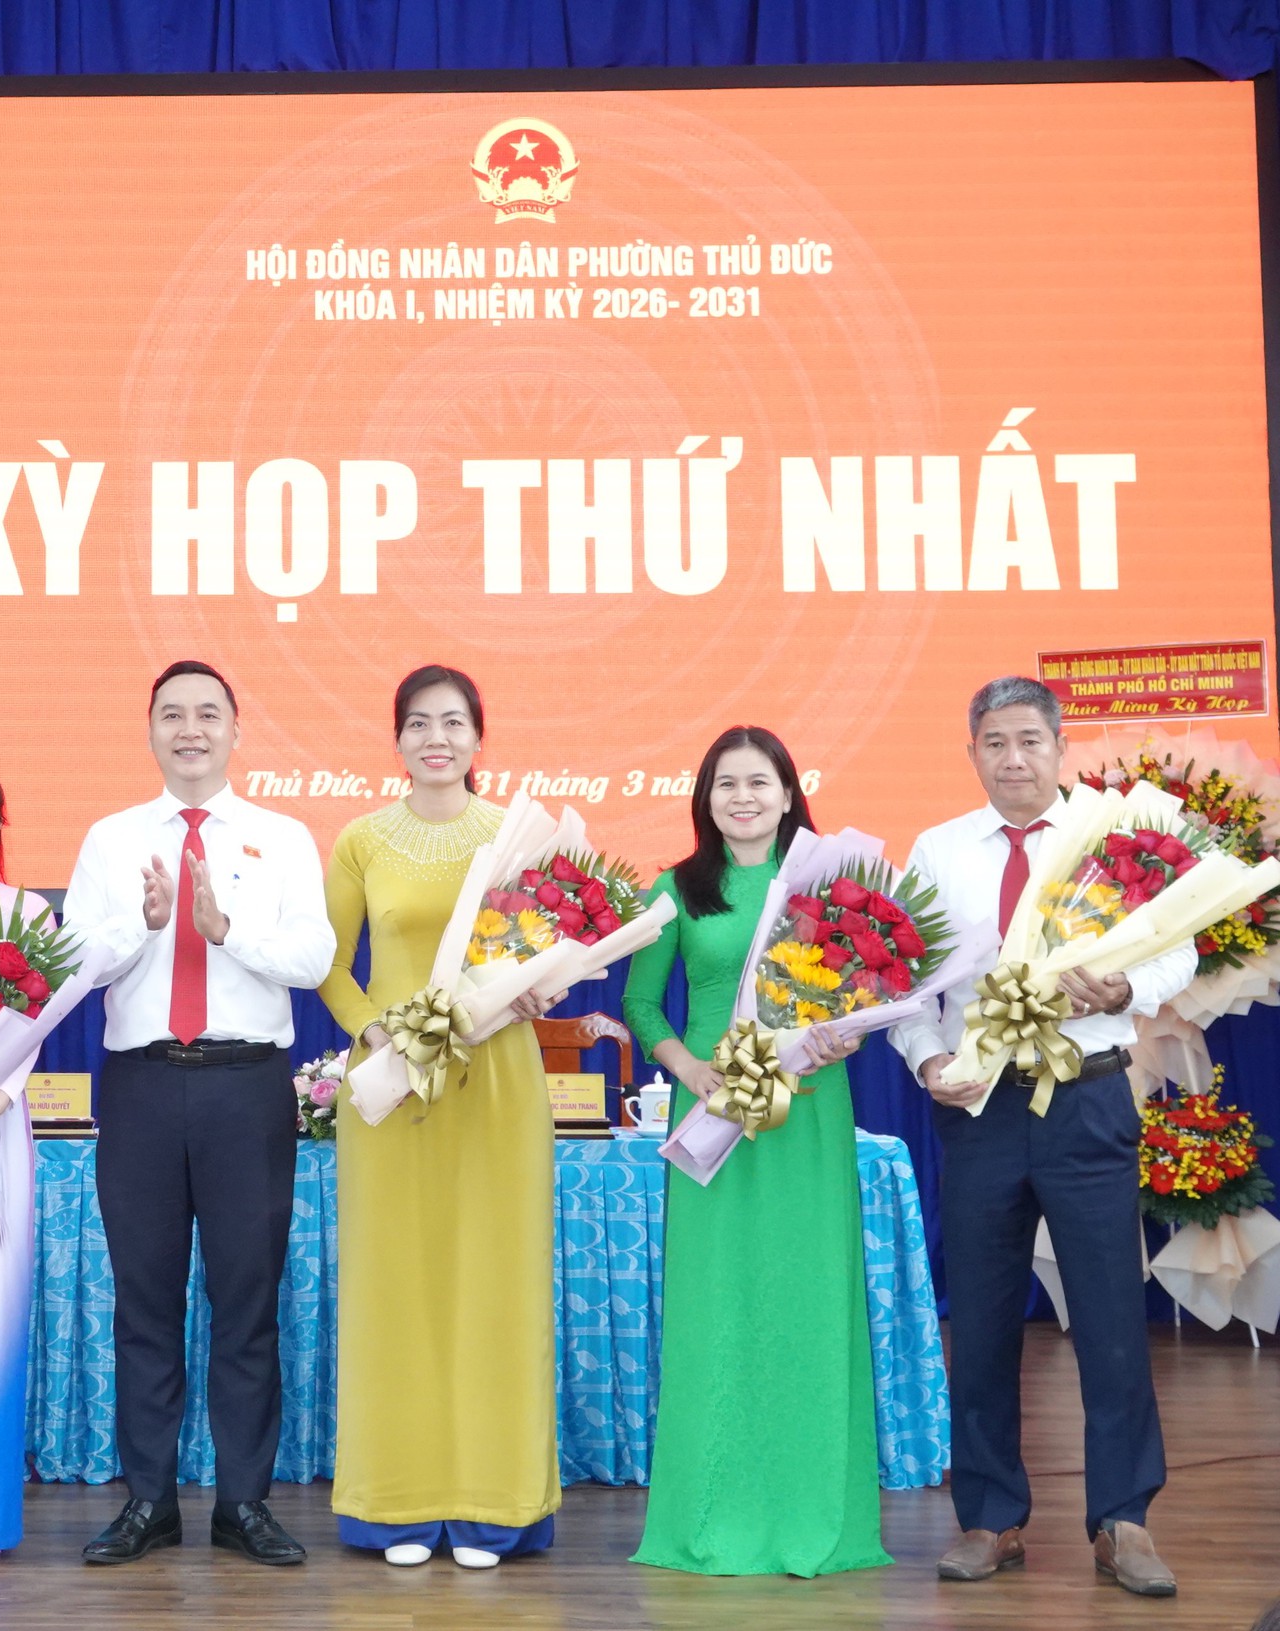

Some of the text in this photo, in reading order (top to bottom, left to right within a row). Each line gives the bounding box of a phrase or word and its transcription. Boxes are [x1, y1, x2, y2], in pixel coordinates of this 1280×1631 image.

[245, 234, 833, 287] HỘI ĐỒNG NHÂN DÂN PHƯỜNG THỦ ĐỨC
[314, 285, 761, 327] KHÓA I, NHIỆM KỲ 2026- 2031
[150, 457, 419, 623] HỌP
[461, 435, 744, 596] THỨ
[780, 407, 1137, 593] NHẤT
[1070, 674, 1234, 697] THÀNH PHỐ HỒ CHÍ MINH
[1105, 699, 1159, 715] Mừng
[1166, 697, 1198, 713] Kỳ
[1205, 695, 1250, 711] Họp
[246, 768, 303, 797] Thủ
[308, 768, 374, 799] Đức,
[474, 770, 511, 797] 31
[520, 768, 610, 803] tháng
[622, 769, 646, 797] 3
[650, 769, 696, 797] nă
